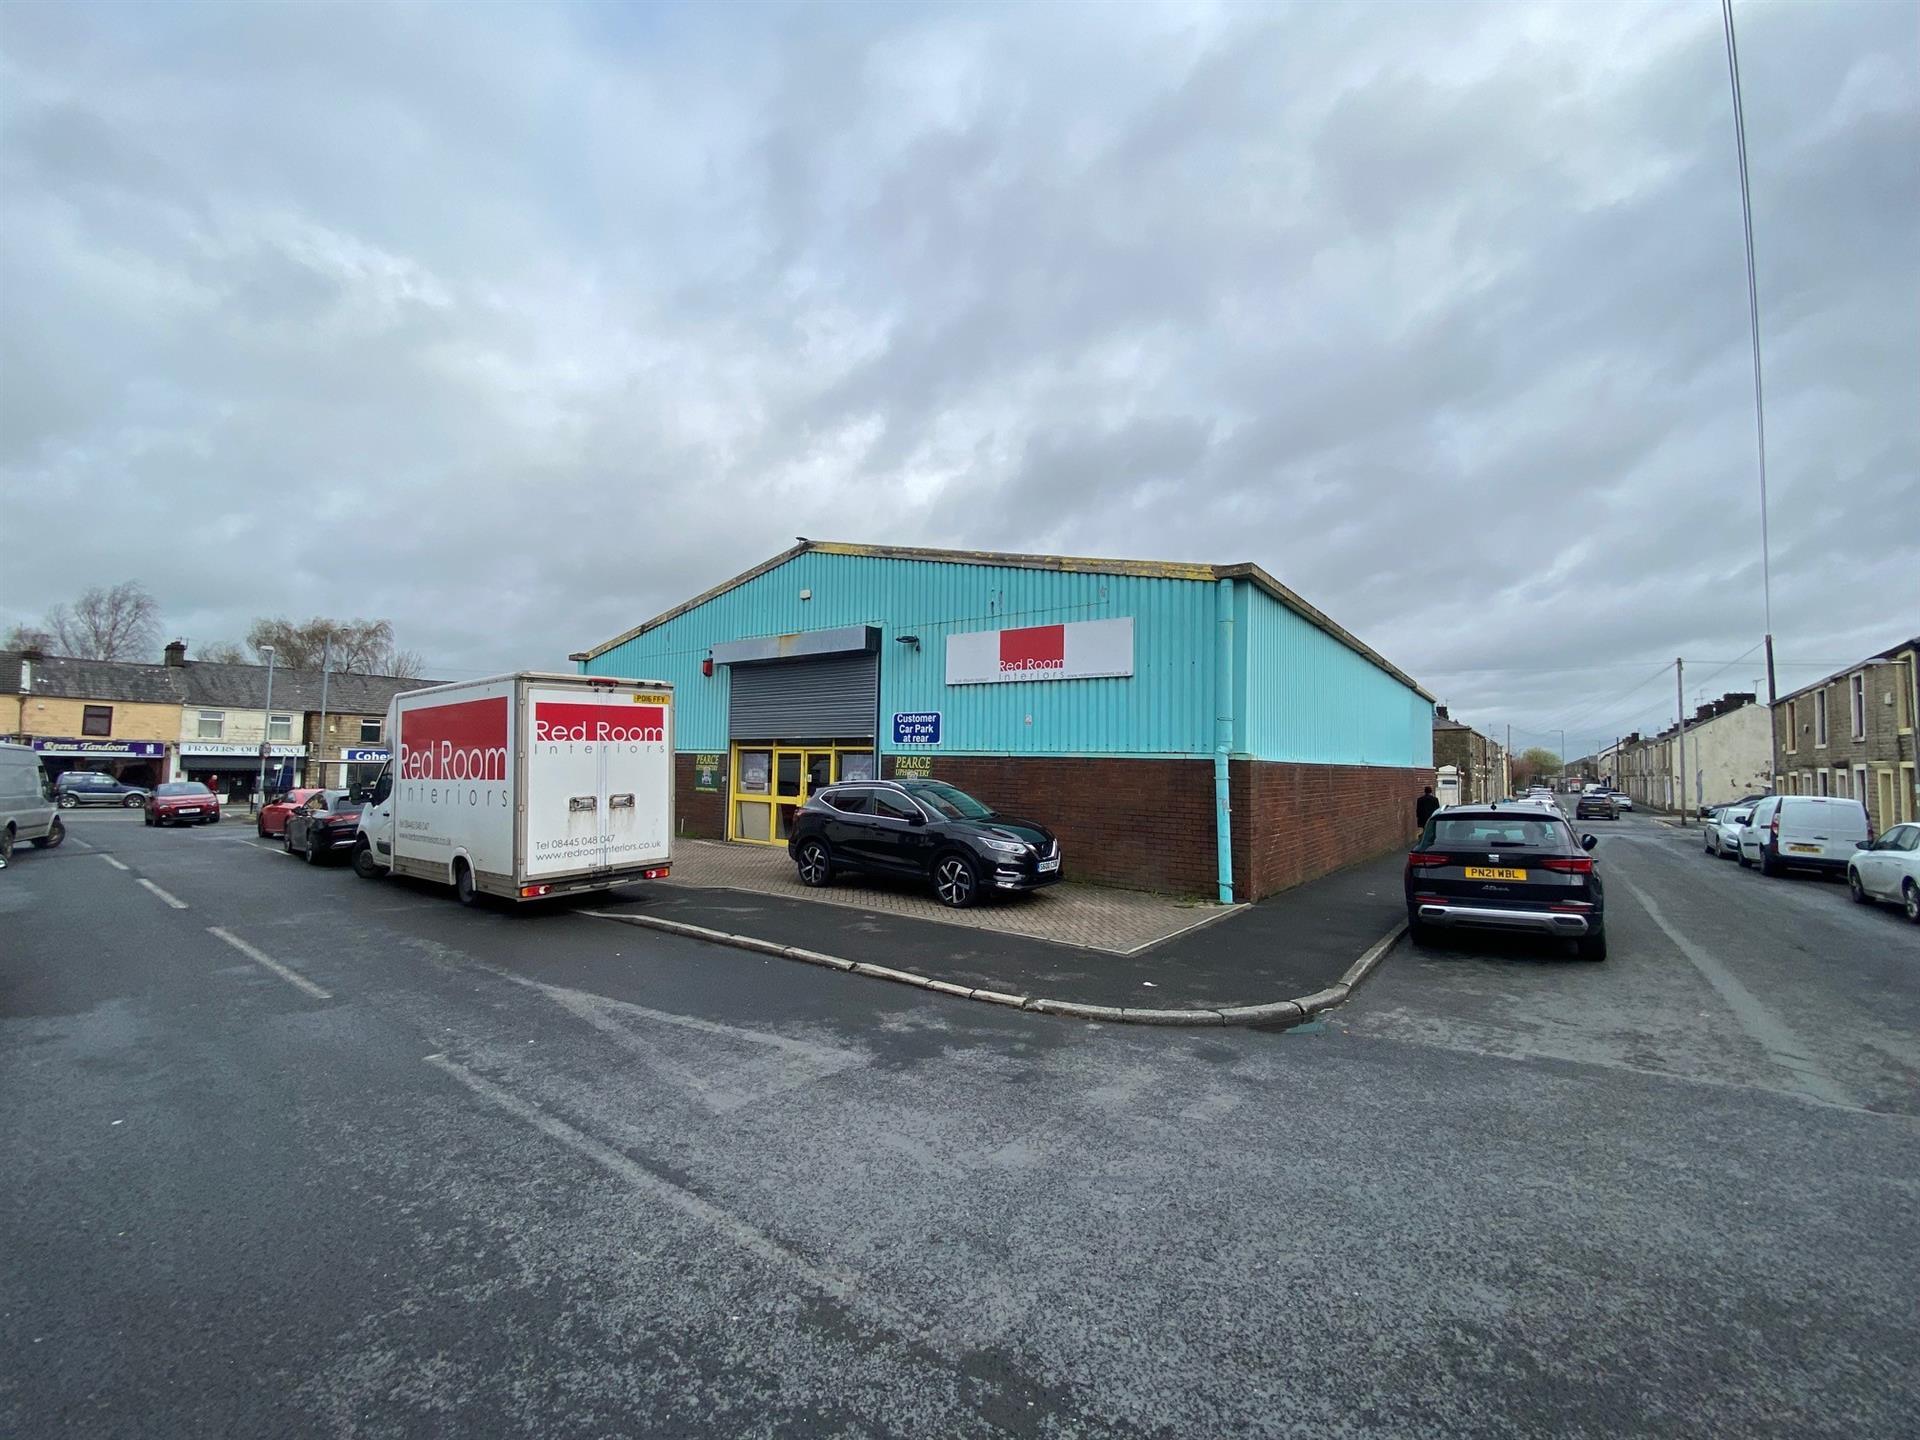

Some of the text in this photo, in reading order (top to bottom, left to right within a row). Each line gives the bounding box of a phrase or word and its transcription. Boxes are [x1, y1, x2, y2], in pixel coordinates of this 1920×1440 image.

[1000, 658, 1064, 672] Red Room
[897, 714, 937, 723] Customer
[536, 720, 664, 741] Red Room
[899, 724, 934, 733] Car Park
[903, 734, 911, 742] at
[43, 741, 130, 752] Reena Tandoori
[534, 743, 665, 754] Interiors
[400, 740, 508, 780] Red Room
[696, 754, 720, 765] PEARCE
[896, 756, 931, 768] PEARCE
[399, 783, 508, 807] Interiors
[536, 834, 615, 850] Tel 08445 048 047
[536, 840, 662, 861] www.redroominteriors.co.uk
[1471, 868, 1519, 879] PN21 WBL
